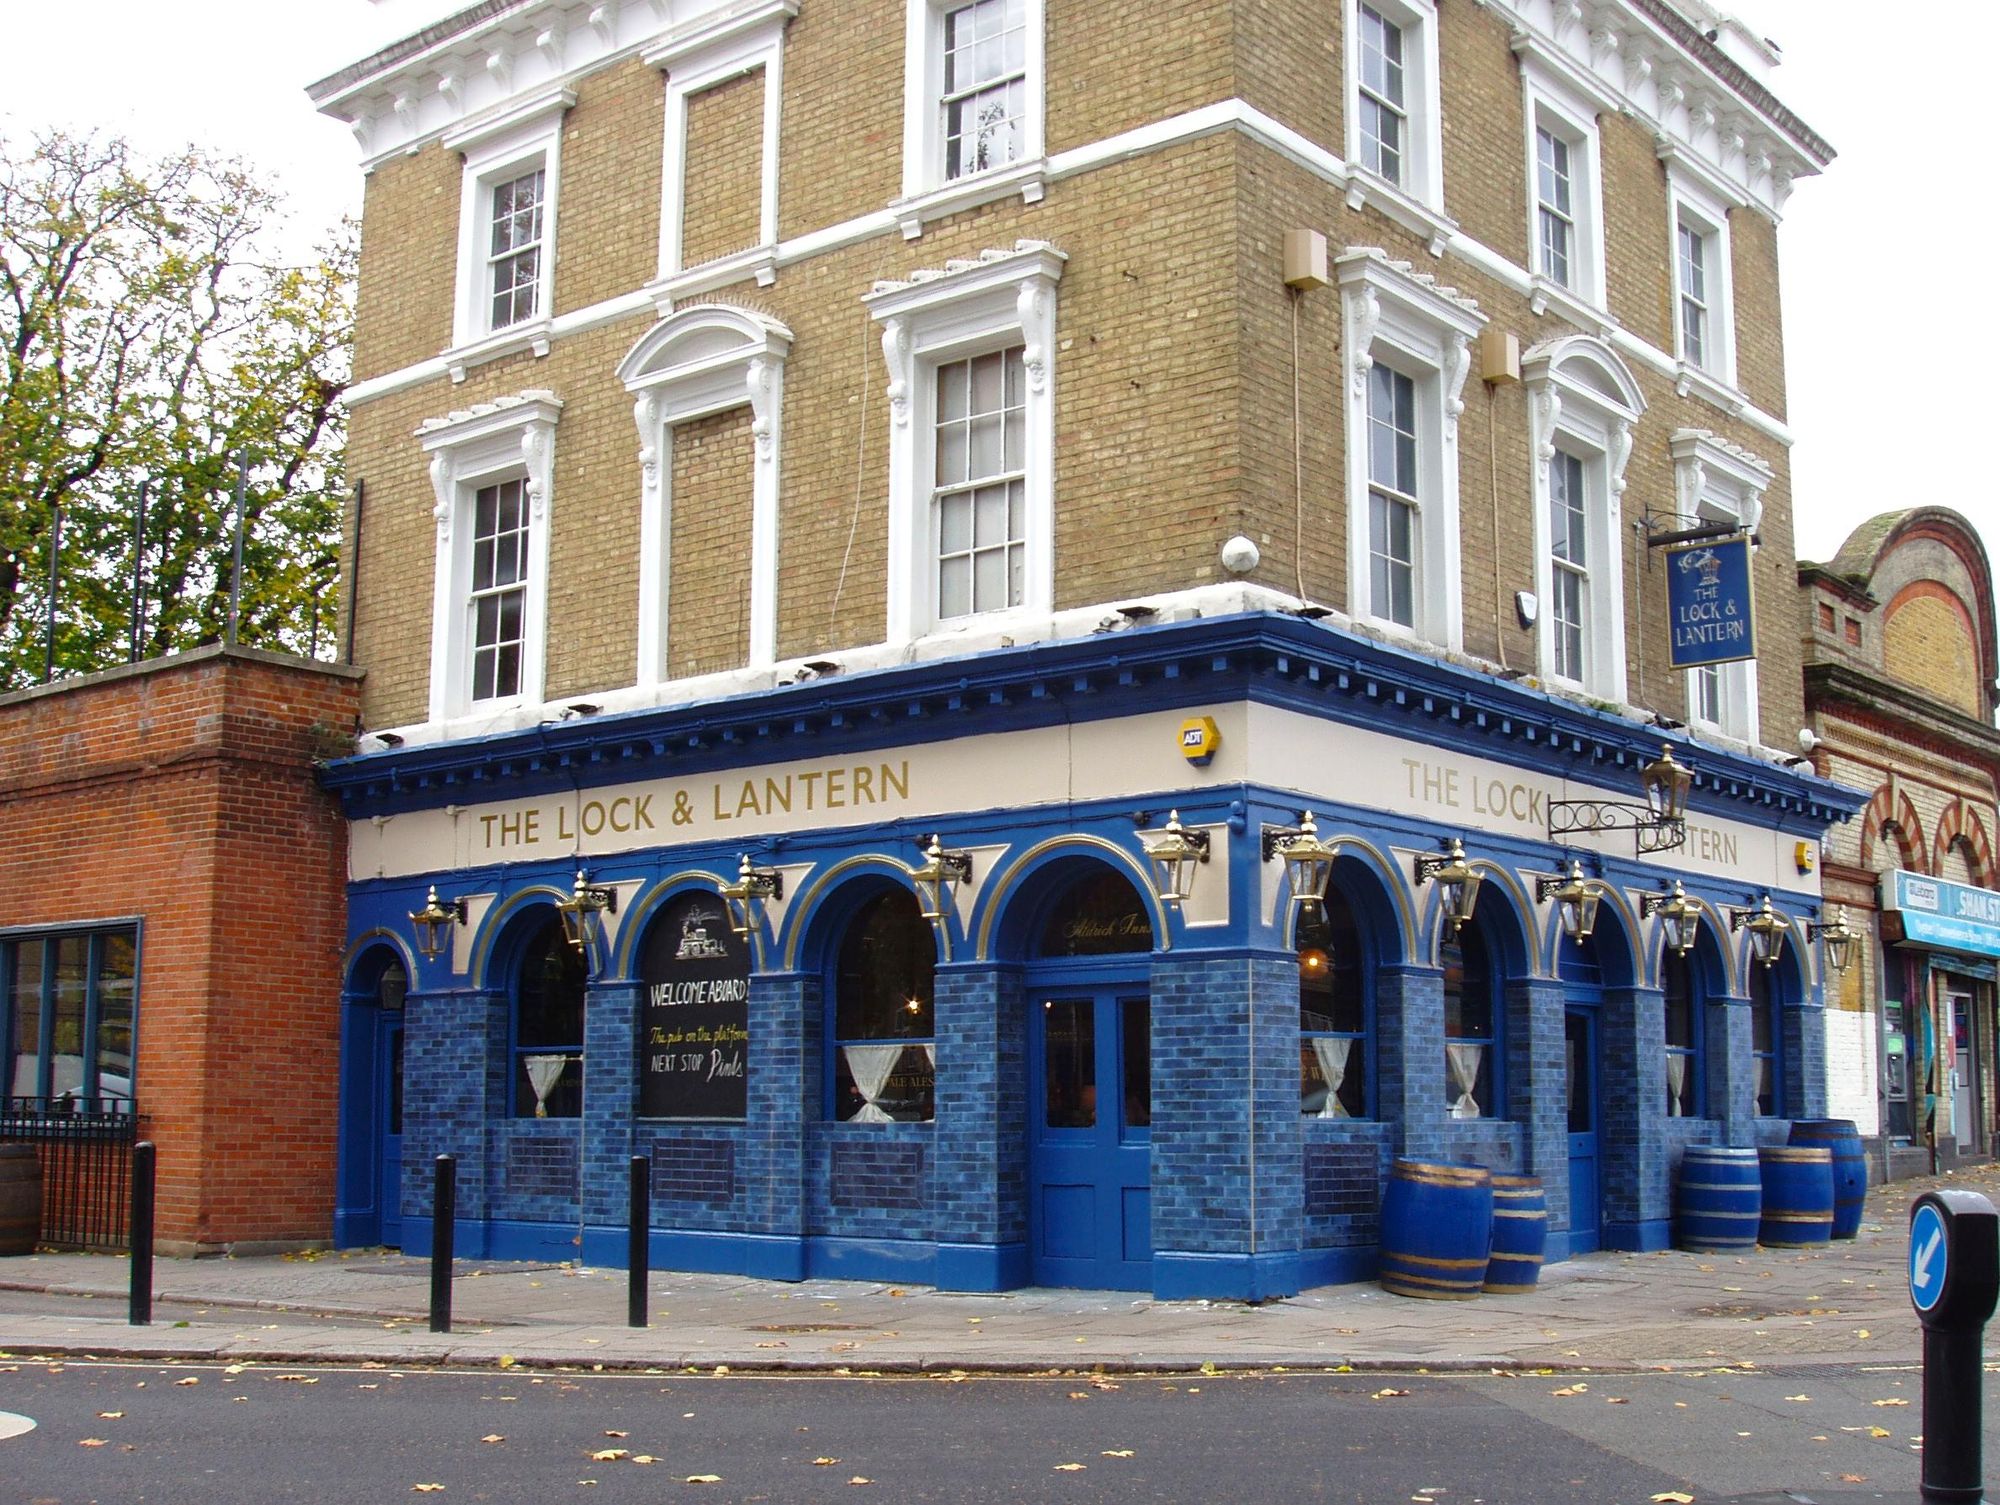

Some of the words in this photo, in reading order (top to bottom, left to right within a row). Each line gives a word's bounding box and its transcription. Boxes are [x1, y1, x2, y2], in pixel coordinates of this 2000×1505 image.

[1693, 587, 1719, 601] THE
[1680, 601, 1722, 623] LOCK
[1725, 598, 1738, 616] &
[1676, 619, 1744, 647] LANTERN
[1183, 731, 1203, 745] ADT
[480, 809, 539, 848] THE
[558, 793, 656, 840] LOCK
[671, 790, 695, 826] &
[713, 760, 909, 821] LANTERN
[1401, 757, 1460, 808] THE
[1472, 775, 1545, 826] LOCK
[650, 981, 709, 1008] WELCOME
[650, 1026, 668, 1045] The
[668, 1026, 683, 1050] pub
[686, 1031, 697, 1043] on
[697, 1025, 712, 1042] the
[651, 1054, 677, 1073] NEXT
[680, 1053, 704, 1072] STOP
